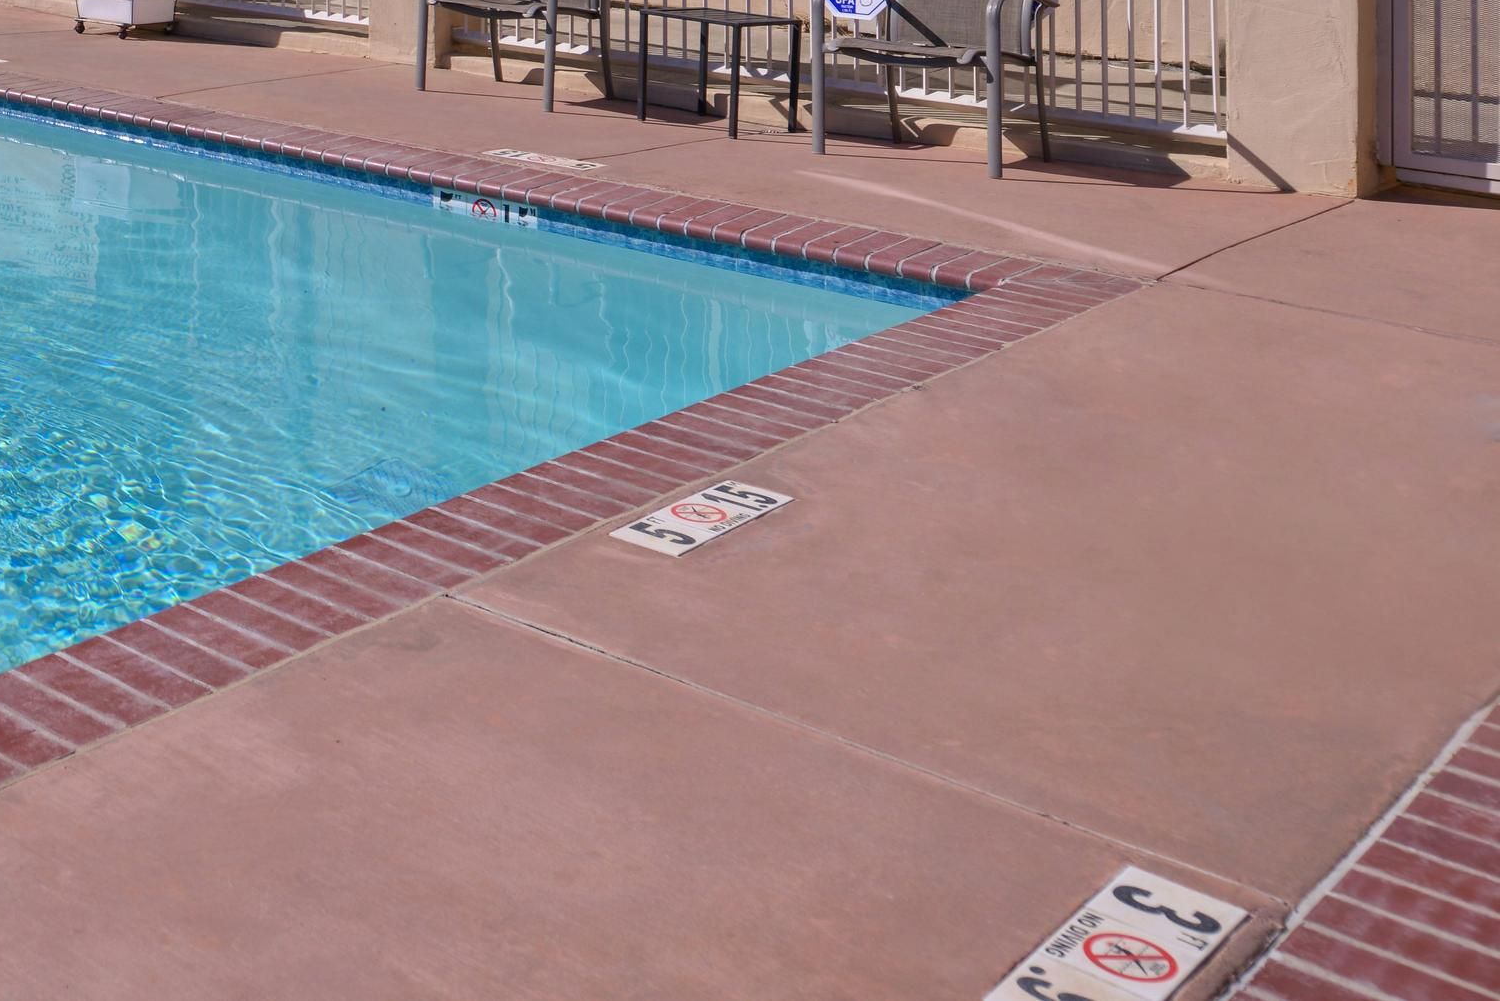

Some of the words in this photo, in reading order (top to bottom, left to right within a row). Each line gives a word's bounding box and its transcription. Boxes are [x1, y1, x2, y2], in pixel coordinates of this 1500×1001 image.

[629, 521, 696, 545] 5
[1077, 912, 1106, 928] NO
[1112, 885, 1222, 934] 3
[1045, 925, 1090, 958] DIVING
